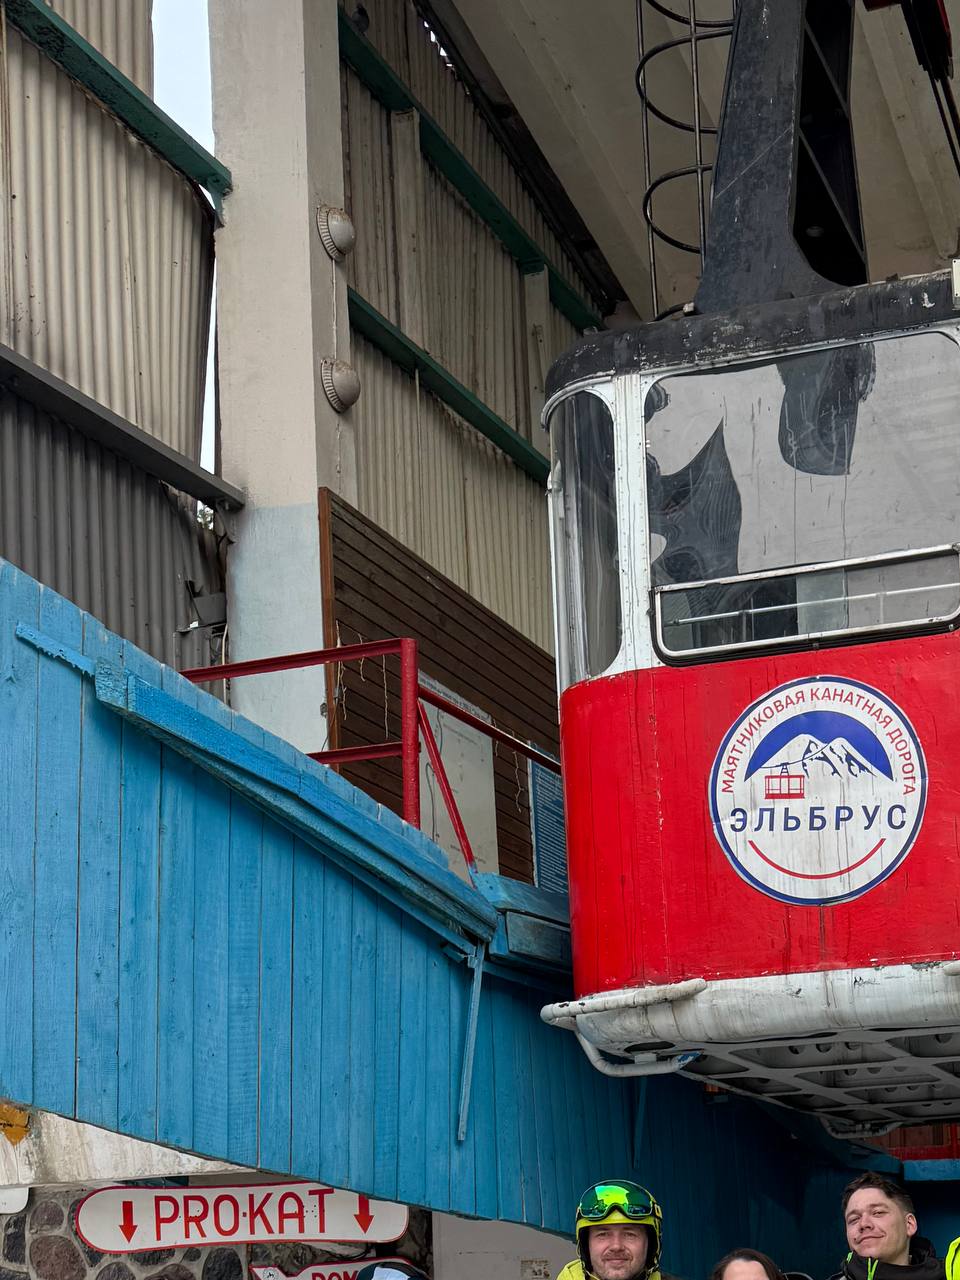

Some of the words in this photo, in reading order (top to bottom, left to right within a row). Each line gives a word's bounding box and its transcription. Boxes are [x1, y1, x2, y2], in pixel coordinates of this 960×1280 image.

[722, 690, 806, 793] МАЯТНИКОВАЯ
[810, 687, 893, 729] КАНАТНАЯ
[885, 727, 917, 795] ДОРОГА
[730, 804, 907, 833] ЭЛЬБРУС
